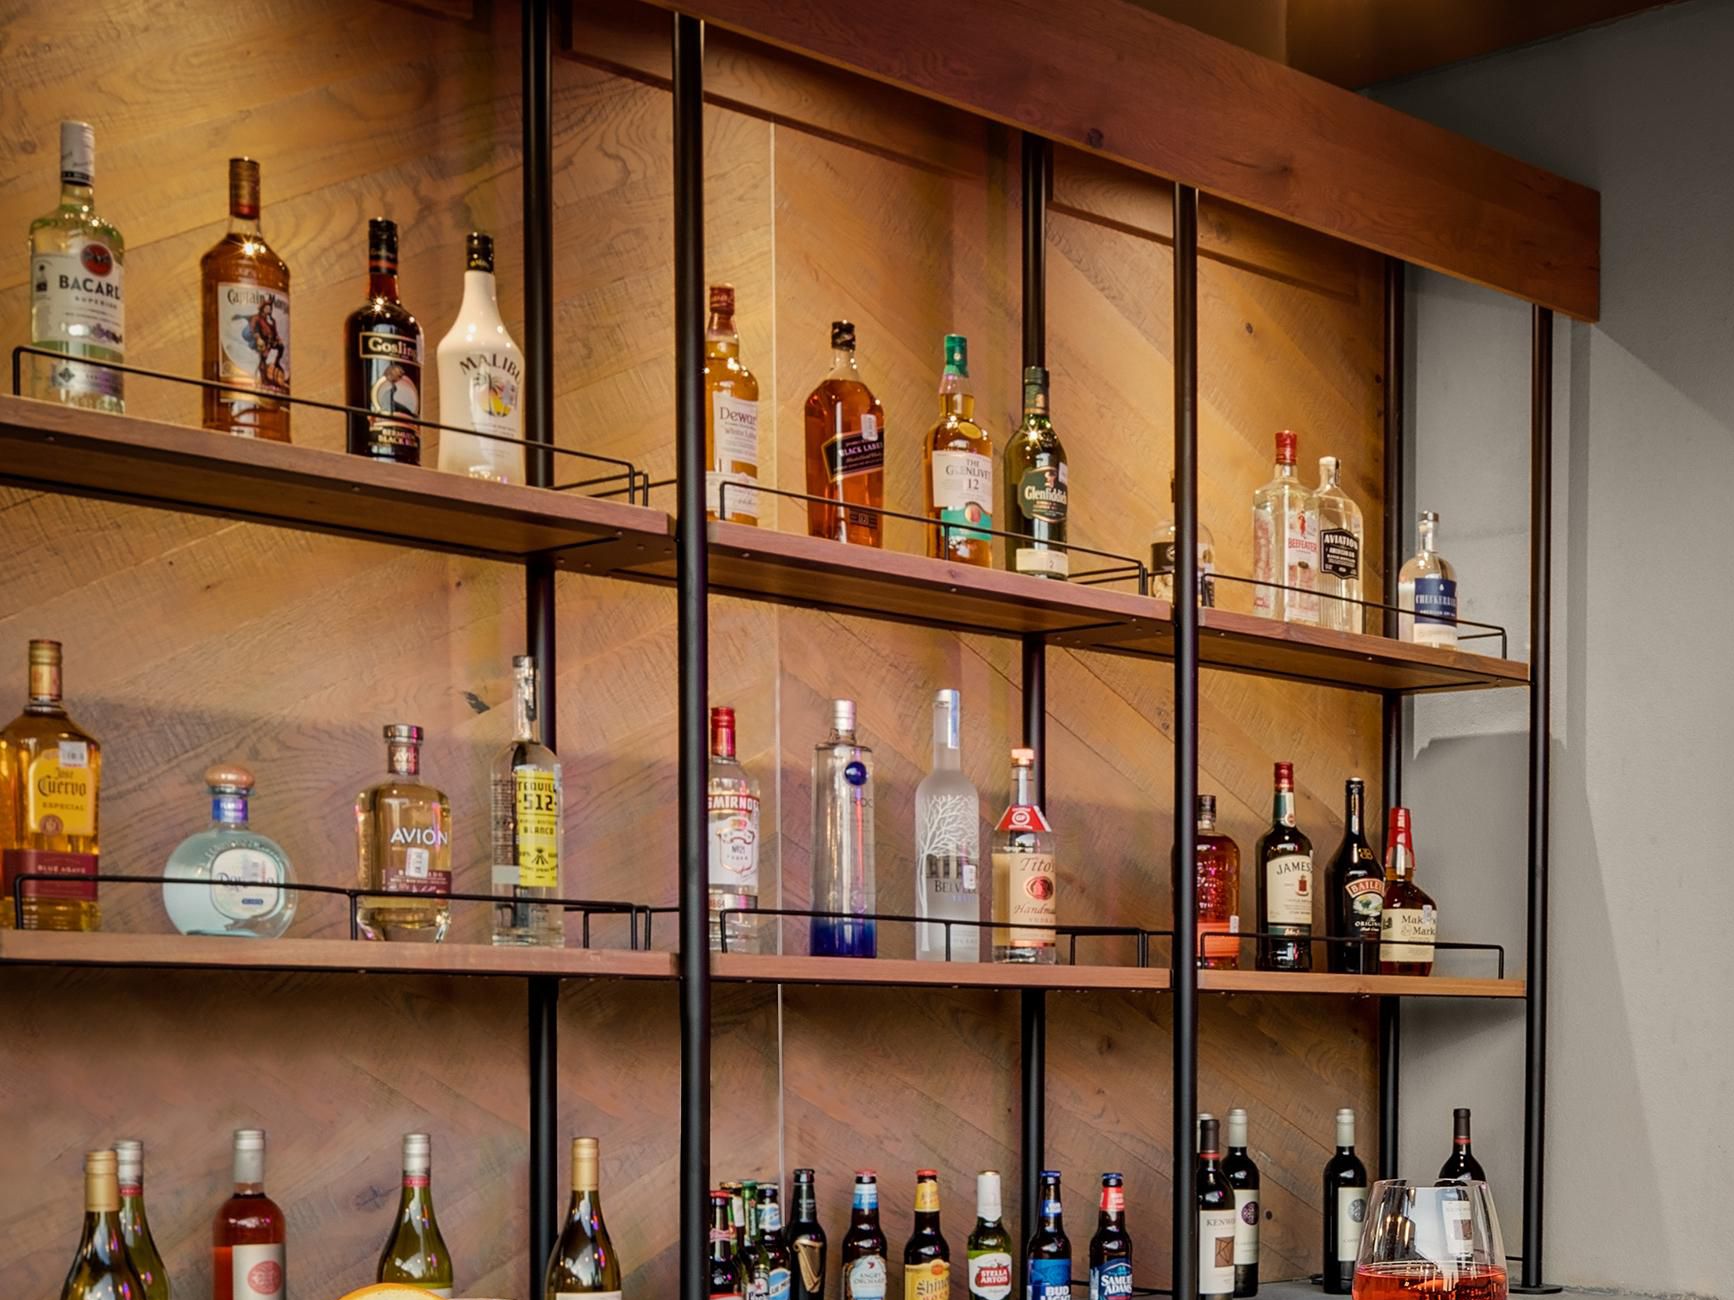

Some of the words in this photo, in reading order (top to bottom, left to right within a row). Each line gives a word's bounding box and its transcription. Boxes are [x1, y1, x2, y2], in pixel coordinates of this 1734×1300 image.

[967, 480, 980, 490] 12
[38, 775, 87, 797] Cuervo
[980, 1269, 1008, 1277] STELLA
[980, 1275, 1008, 1285] ARTOIS
[1045, 1285, 1069, 1298] BUD
